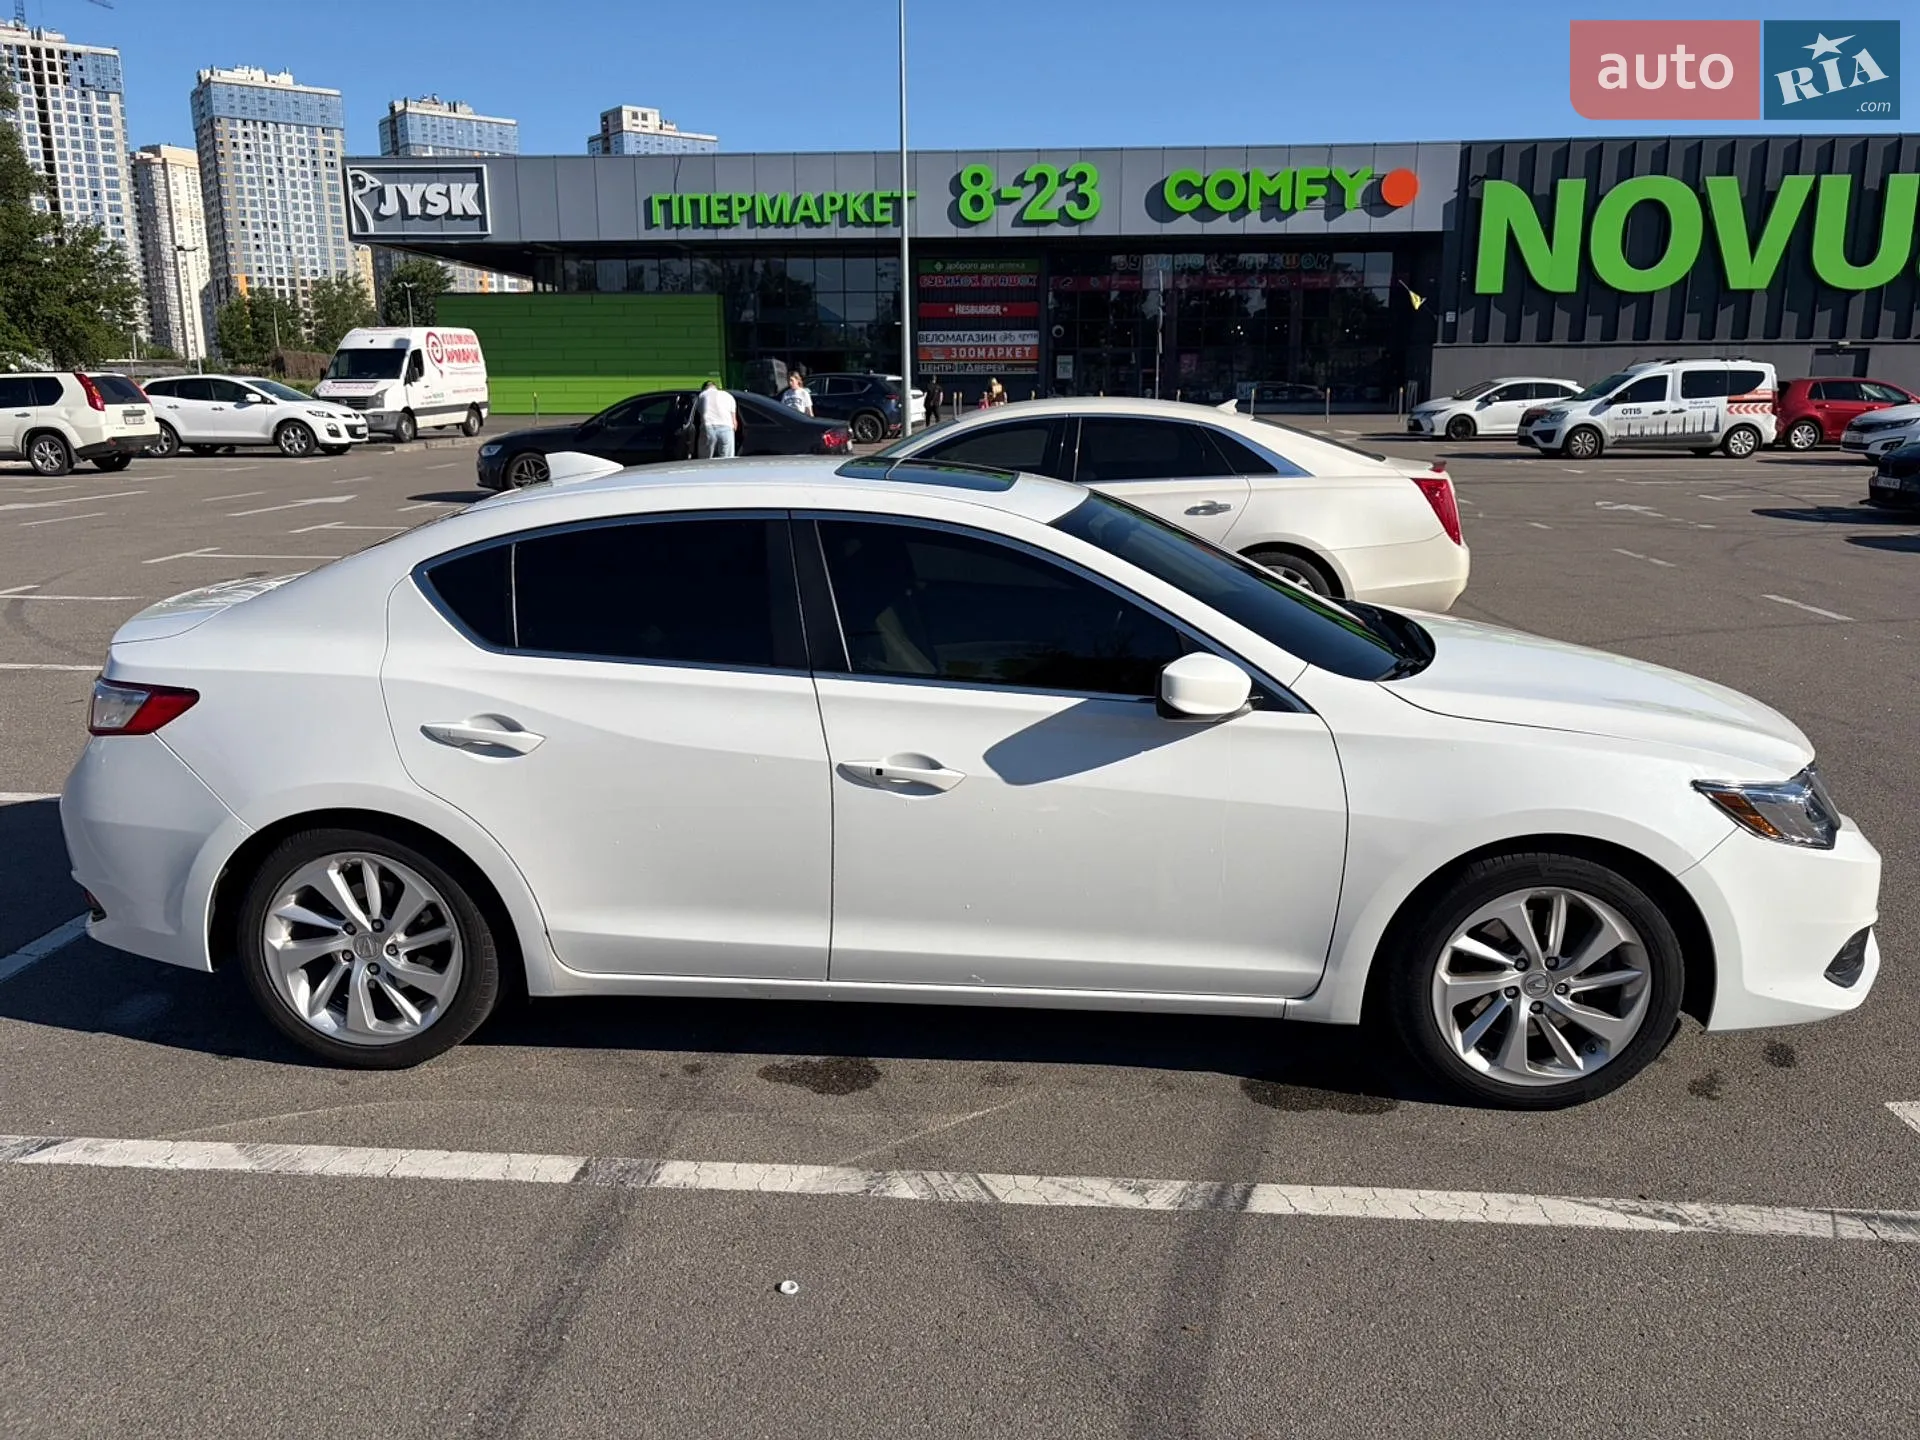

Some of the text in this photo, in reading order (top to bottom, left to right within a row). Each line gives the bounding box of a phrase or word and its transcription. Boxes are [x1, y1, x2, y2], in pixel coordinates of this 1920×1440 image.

[379, 182, 483, 216] JYSK
[958, 161, 1101, 222] 8-23
[1163, 166, 1374, 213] COMFY
[1474, 173, 1920, 295] NOVU
[918, 333, 996, 343] ВЕЛОМАГАЗИН
[950, 346, 1032, 358] ЗООМАРКЕТ
[1621, 407, 1642, 415] OTIS
